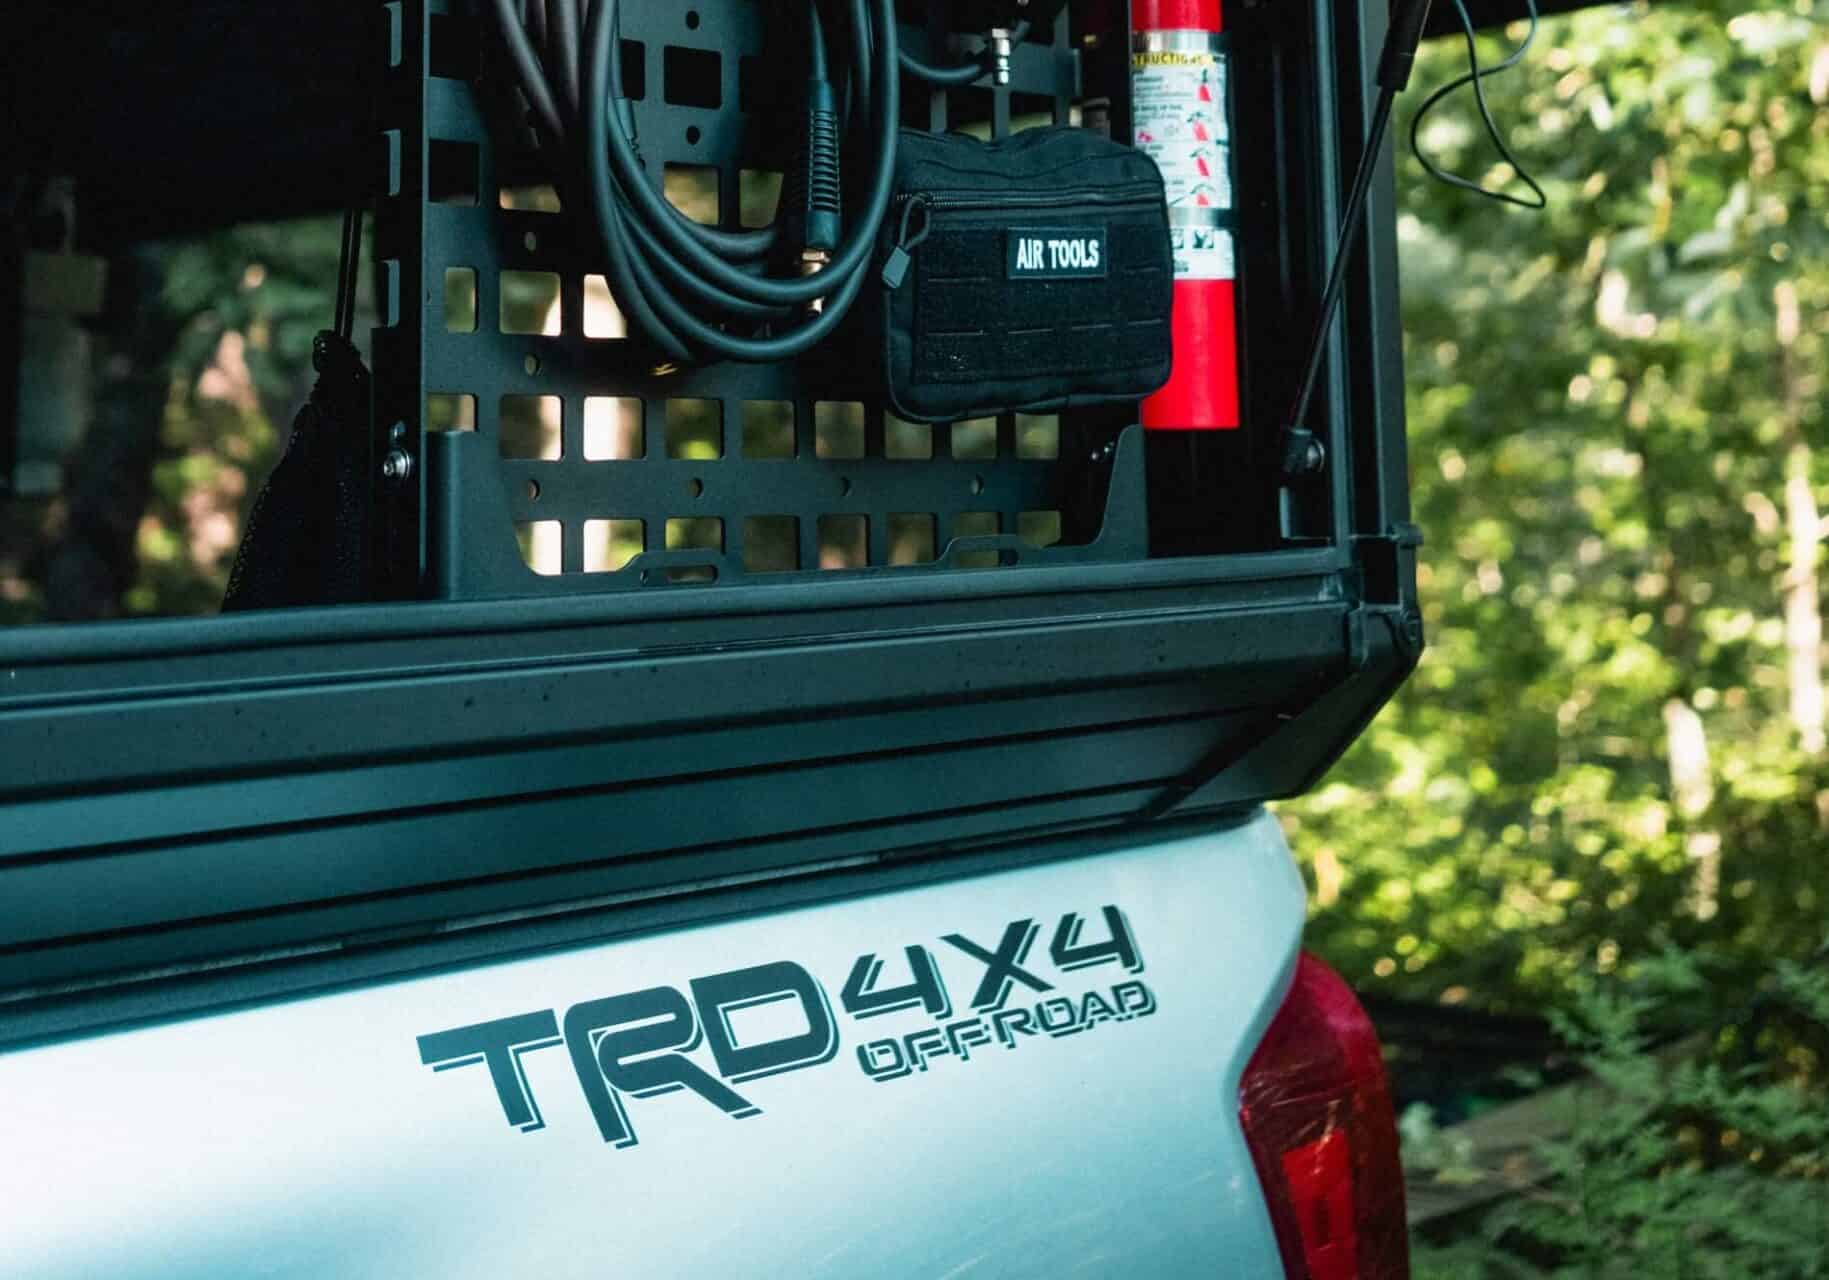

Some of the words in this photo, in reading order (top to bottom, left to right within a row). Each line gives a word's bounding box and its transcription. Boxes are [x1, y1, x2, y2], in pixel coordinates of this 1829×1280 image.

[1016, 238, 1045, 269] AIR
[1047, 238, 1100, 269] TOOLS
[416, 958, 841, 1150] TRD
[839, 903, 1149, 1021] 4X4
